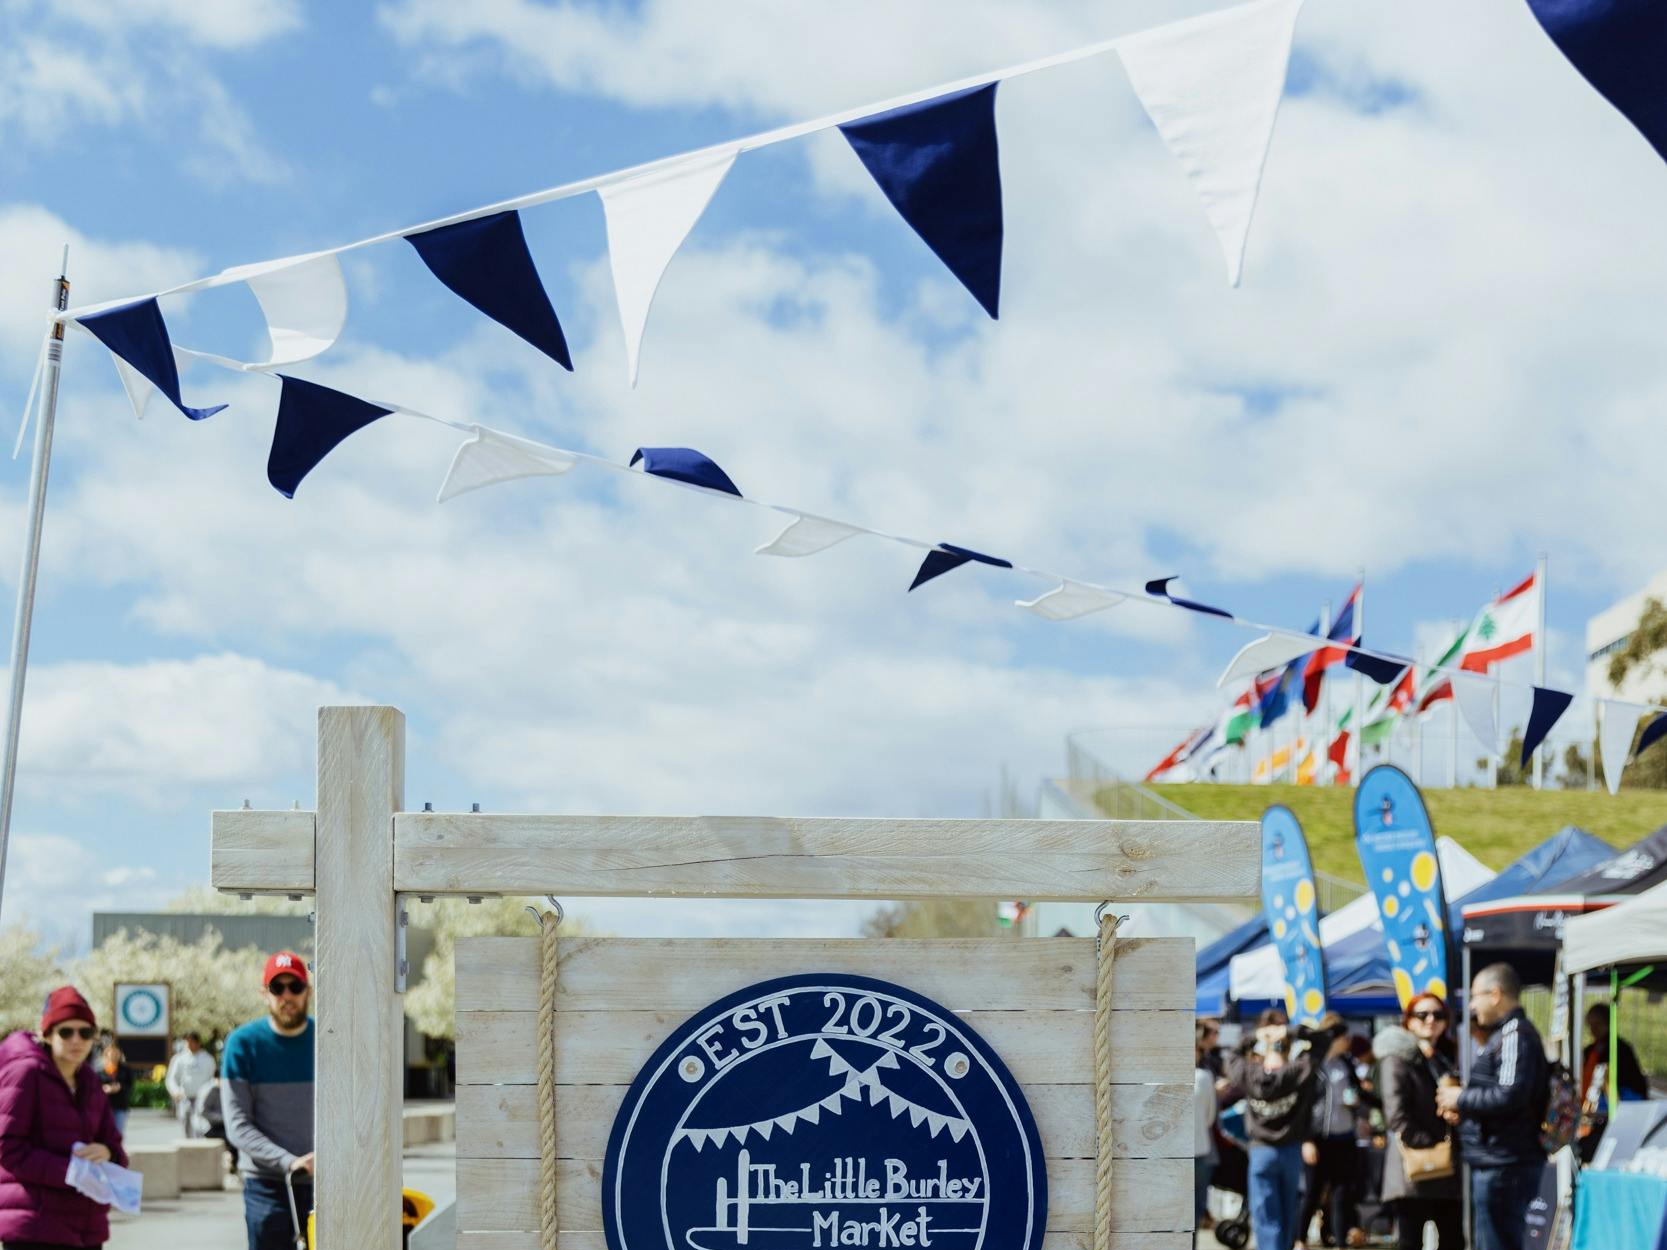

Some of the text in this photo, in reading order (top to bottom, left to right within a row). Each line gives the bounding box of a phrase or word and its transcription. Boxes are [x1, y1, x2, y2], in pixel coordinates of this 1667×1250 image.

[696, 991, 946, 1071] EST 2022
[750, 1157, 982, 1200] The Little Burley
